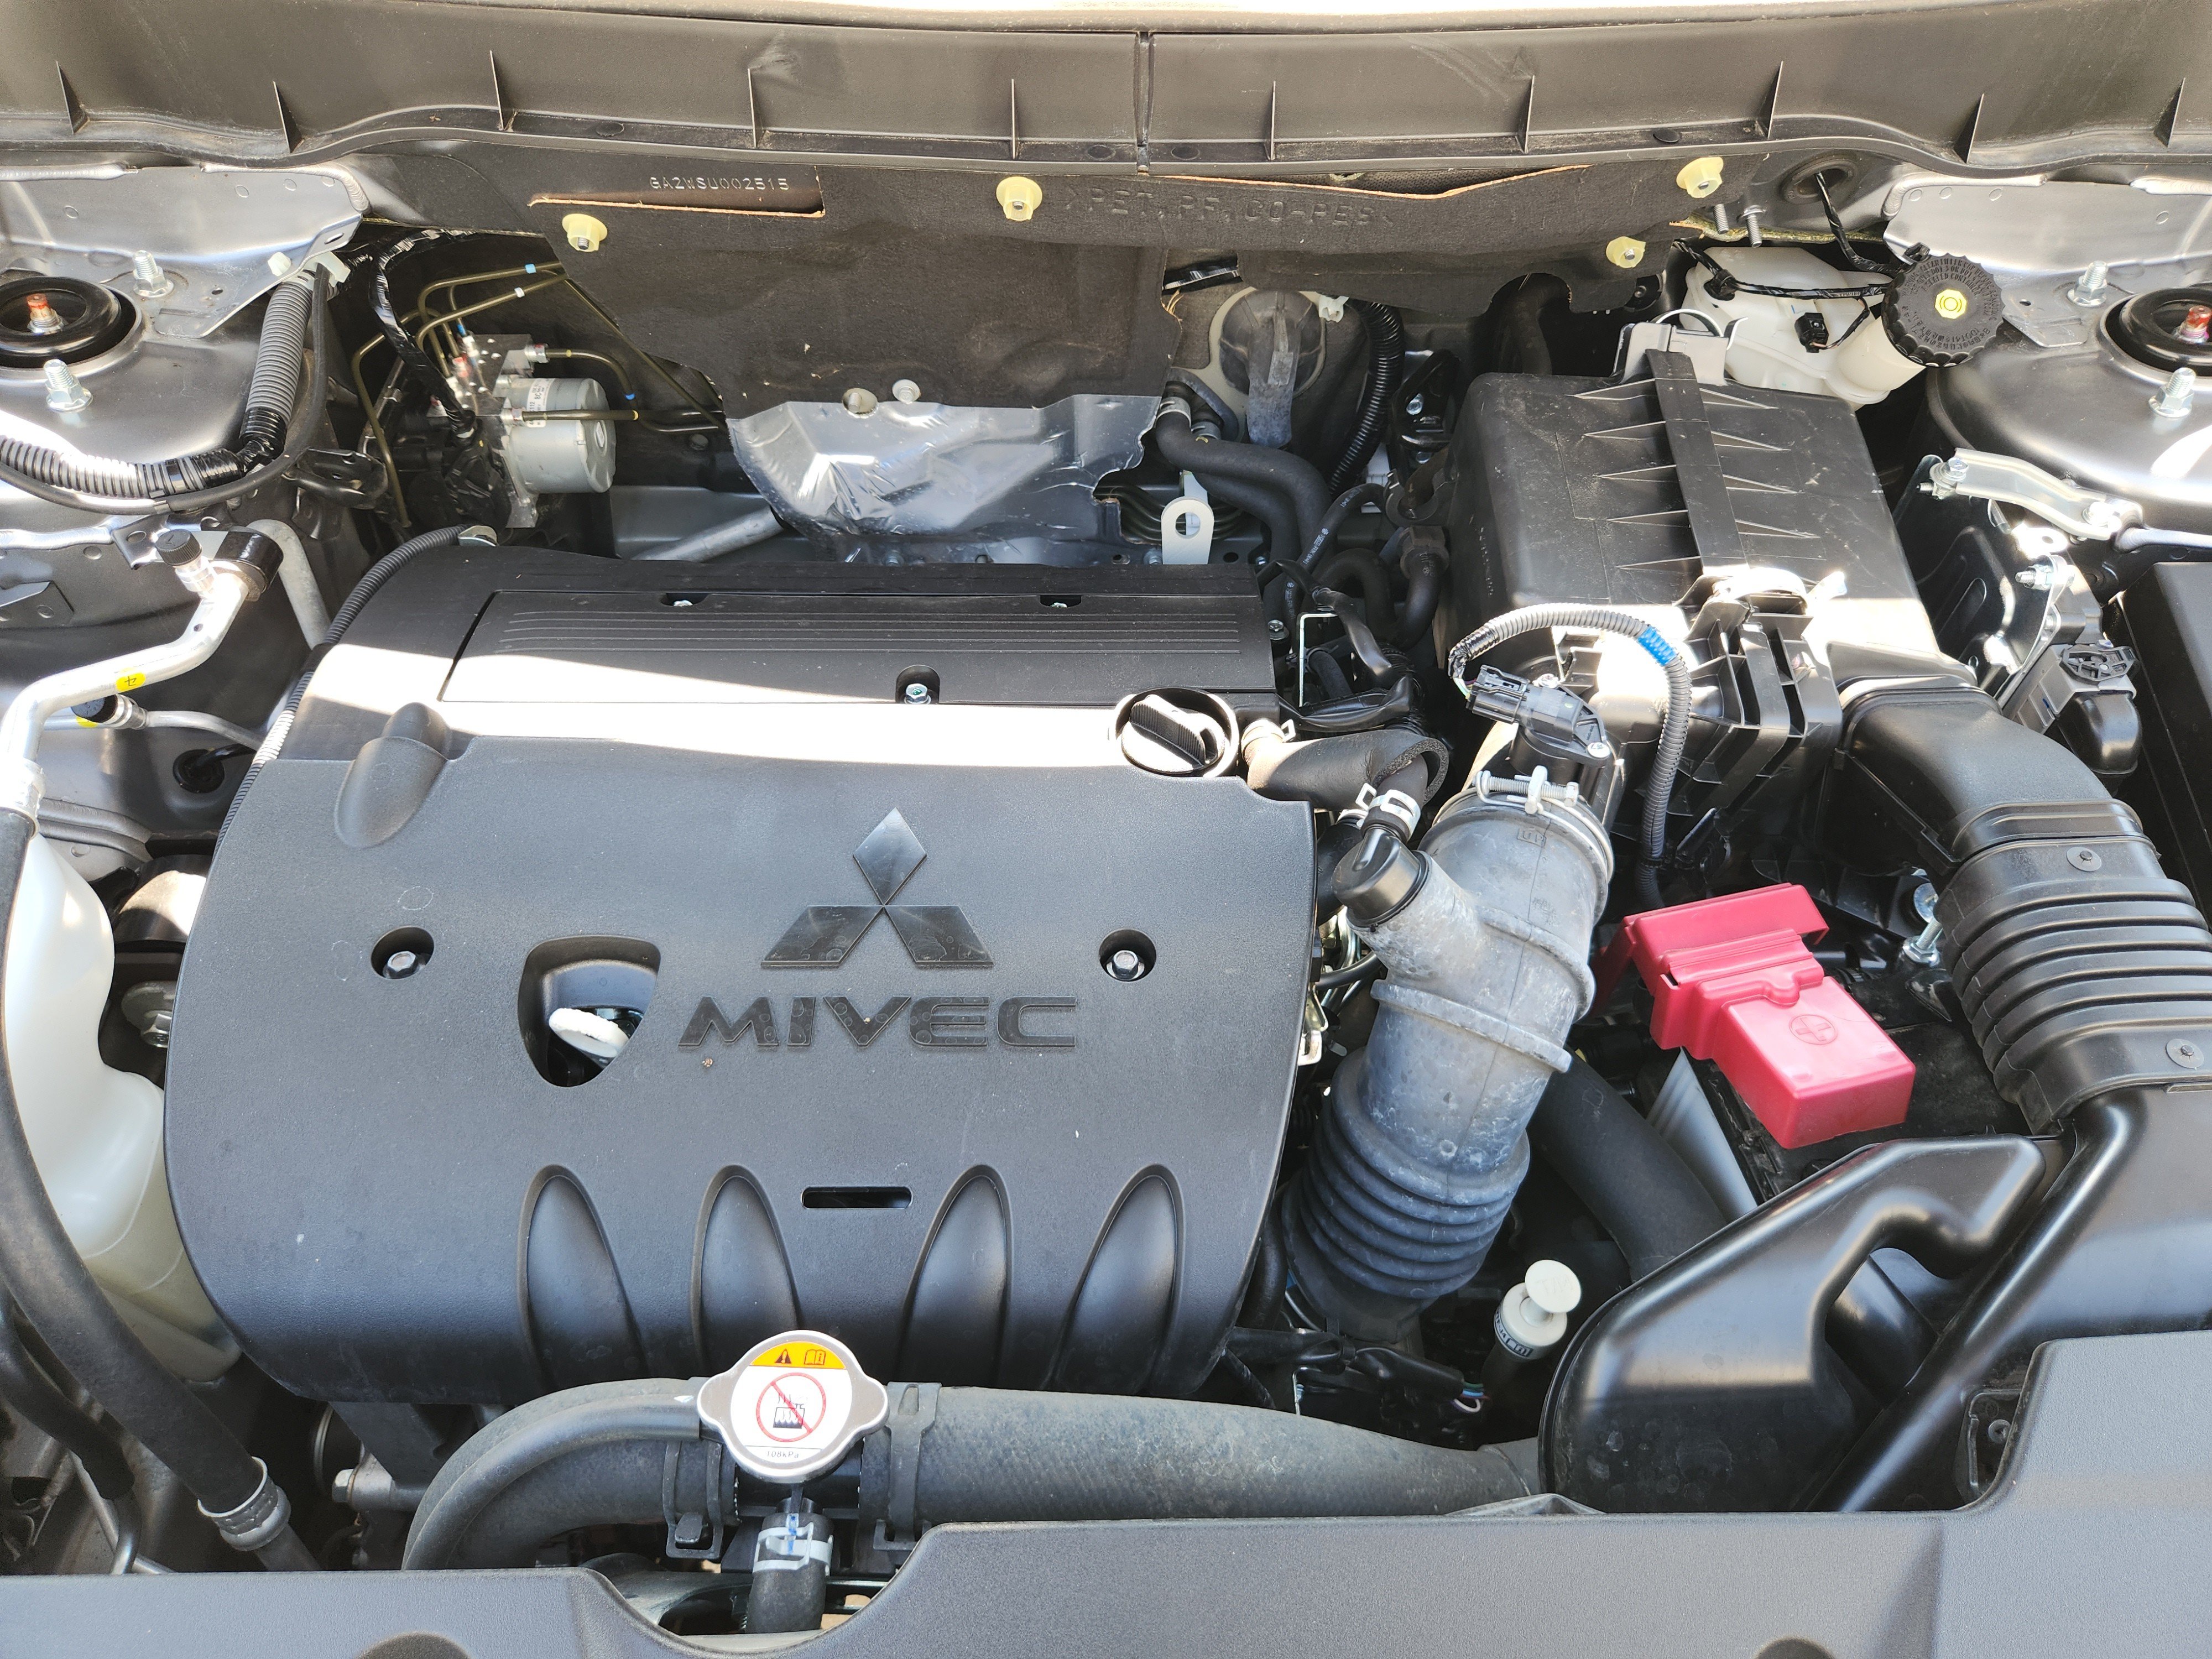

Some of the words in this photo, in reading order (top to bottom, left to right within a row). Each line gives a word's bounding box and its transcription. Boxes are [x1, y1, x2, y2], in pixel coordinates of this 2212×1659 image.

[649, 176, 790, 191] GA2WSU002515
[677, 995, 1077, 1048] MIVEC
[766, 1451, 799, 1459] 108kPa
